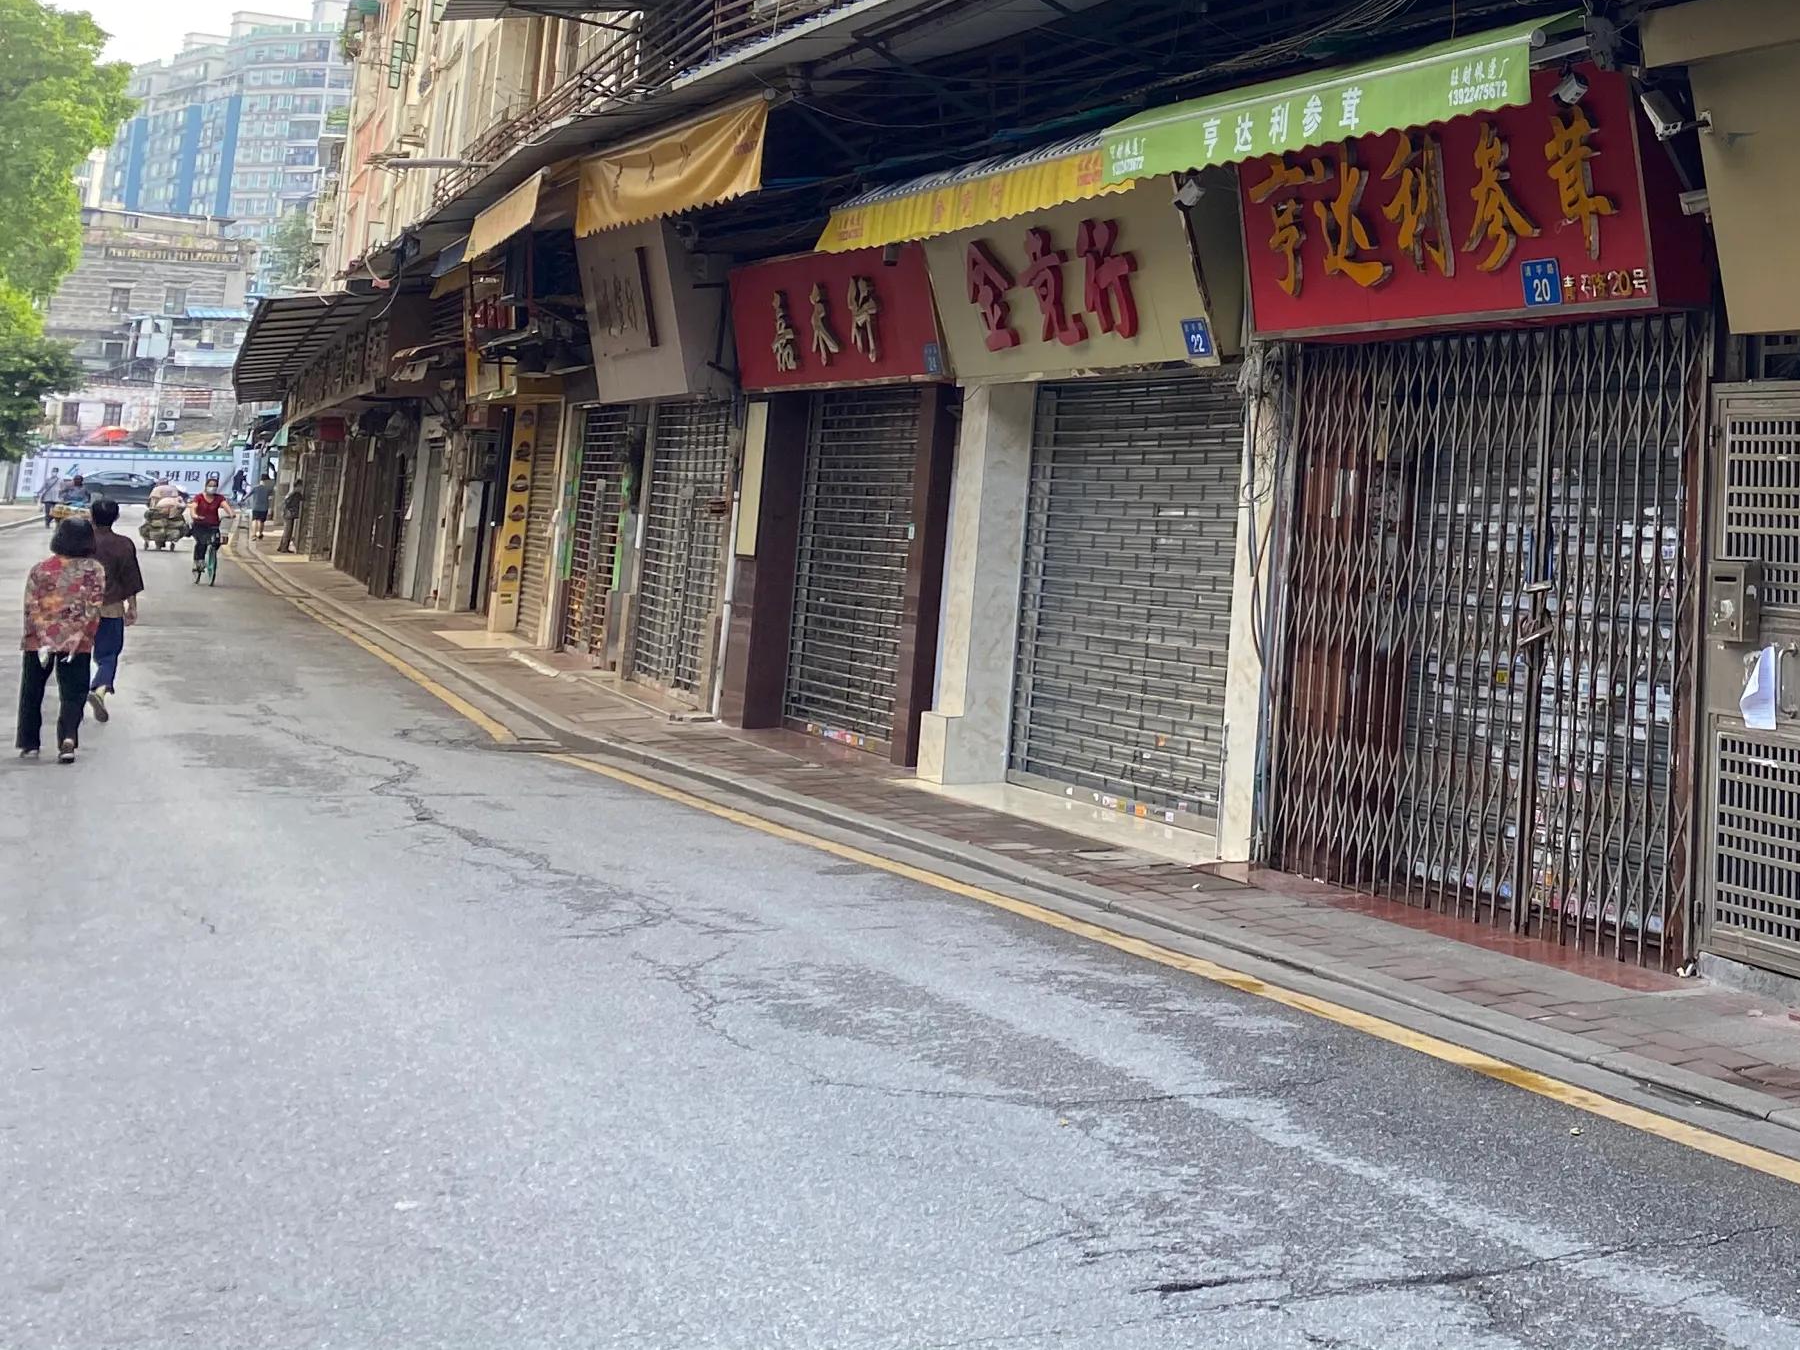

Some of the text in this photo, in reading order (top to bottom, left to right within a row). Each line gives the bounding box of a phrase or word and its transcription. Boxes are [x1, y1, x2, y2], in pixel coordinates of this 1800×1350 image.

[1202, 88, 1362, 159] 亨达利参茸
[1533, 278, 1551, 302] 20
[1191, 334, 1206, 353] 22
